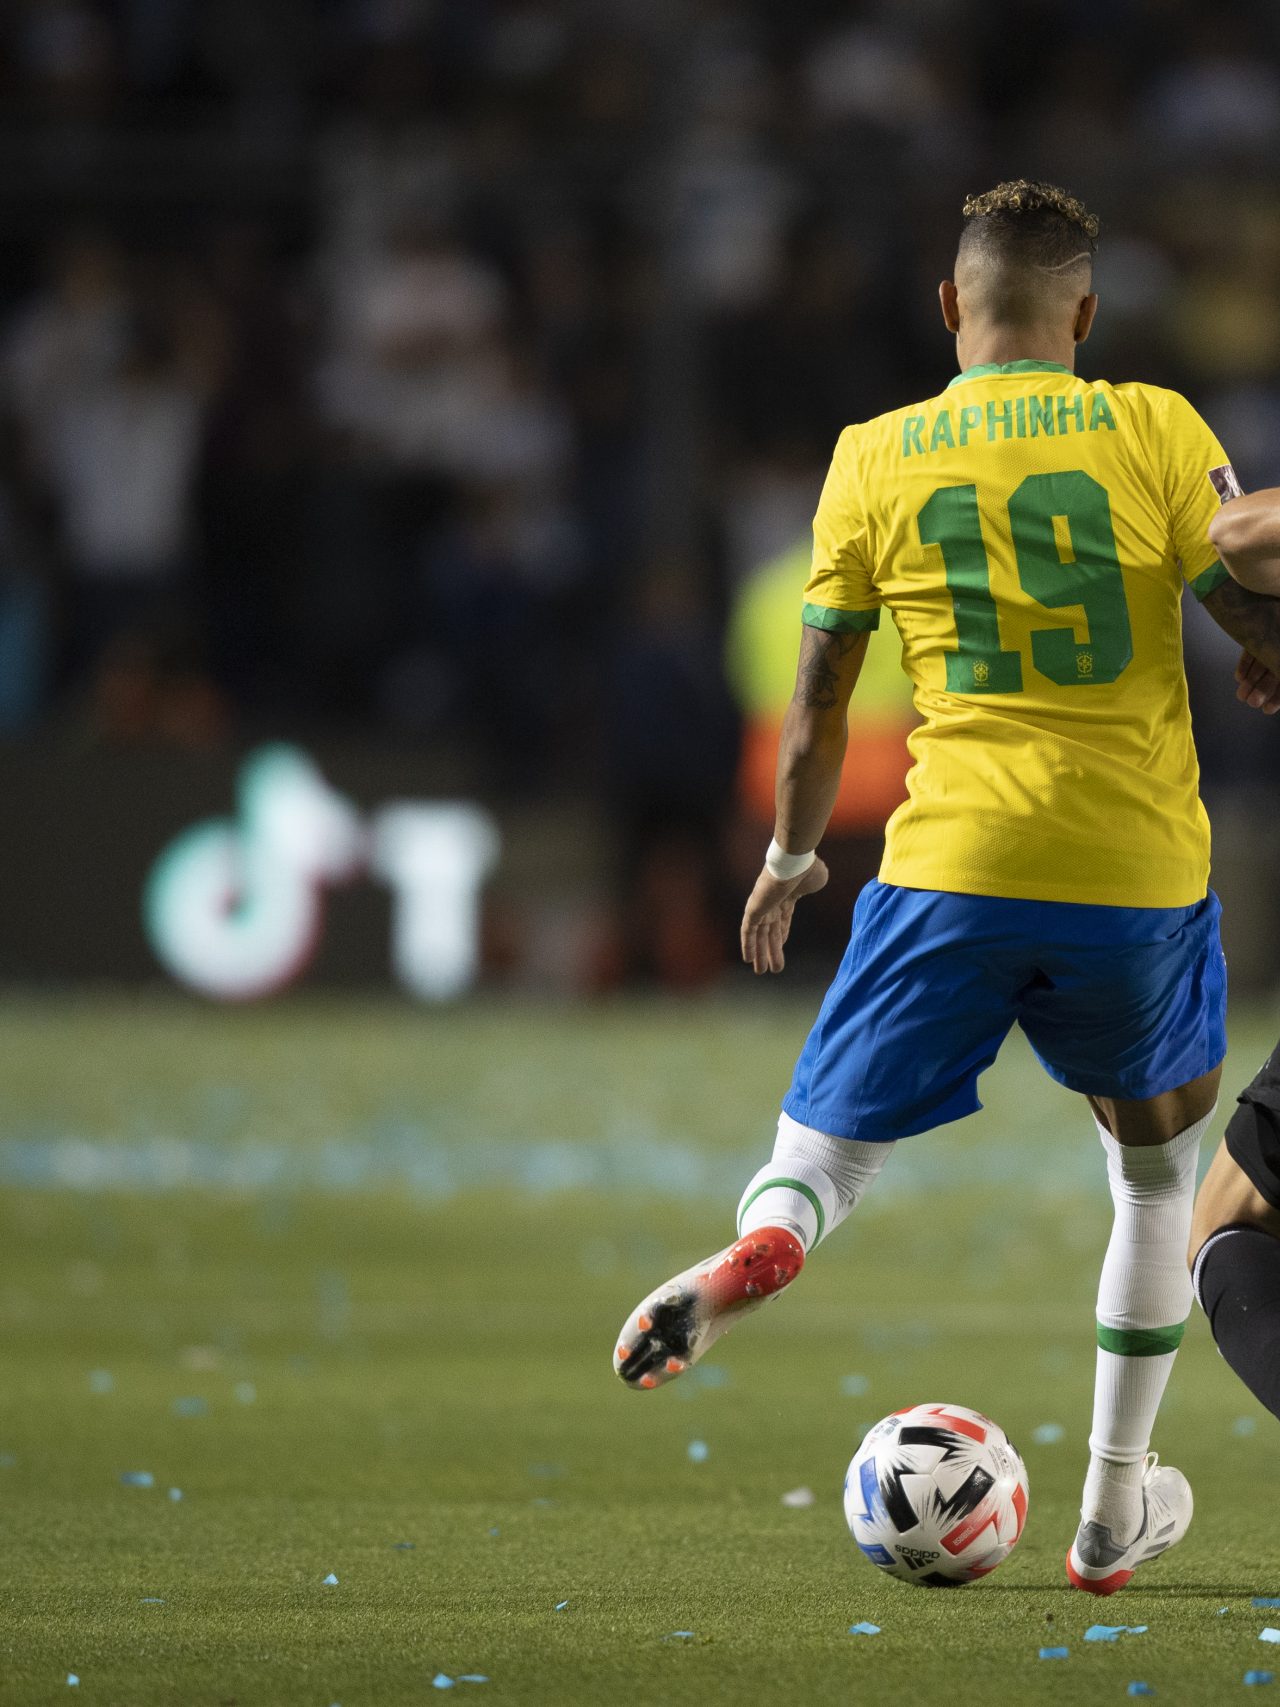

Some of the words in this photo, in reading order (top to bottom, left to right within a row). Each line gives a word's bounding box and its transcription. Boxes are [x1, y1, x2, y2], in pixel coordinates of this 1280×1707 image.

[903, 393, 1116, 457] RAPHINHA
[917, 470, 1133, 694] 19
[894, 1544, 940, 1559] adidas
